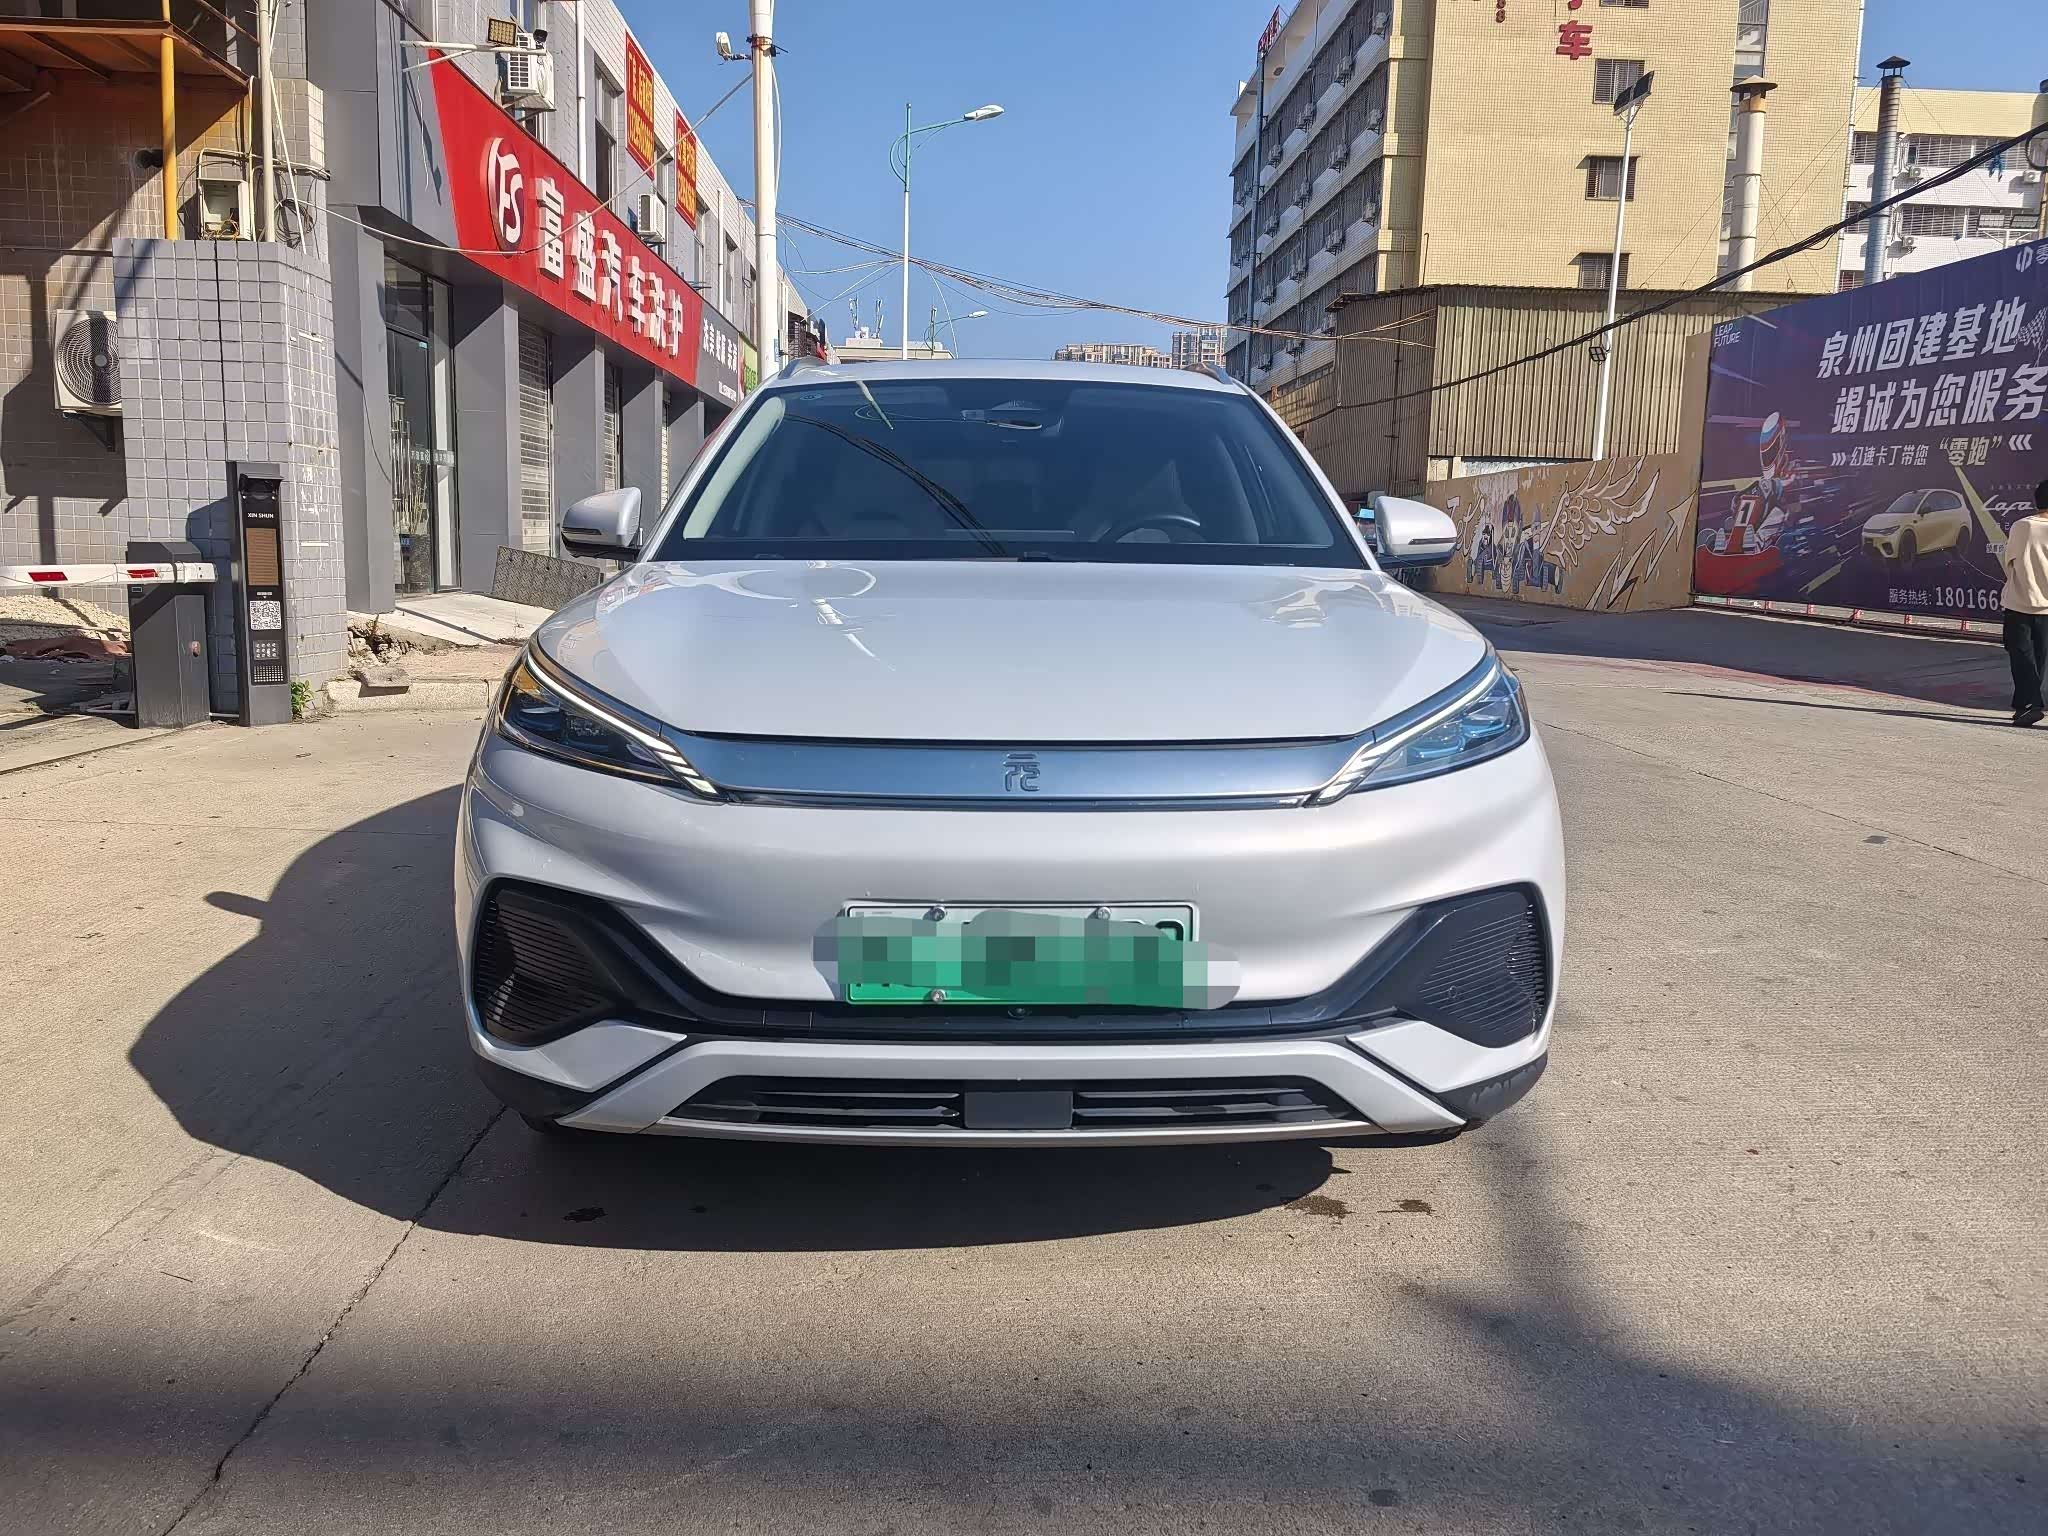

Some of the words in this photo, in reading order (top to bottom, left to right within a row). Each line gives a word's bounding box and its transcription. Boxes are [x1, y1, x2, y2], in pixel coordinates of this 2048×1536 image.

[1556, 0, 1593, 60] 车
[1714, 331, 1741, 348] FUTURE
[1816, 296, 2027, 379] 泉州团建基地
[1831, 363, 2048, 434] 竭诚为您服务
[1935, 586, 2005, 611] 180166
